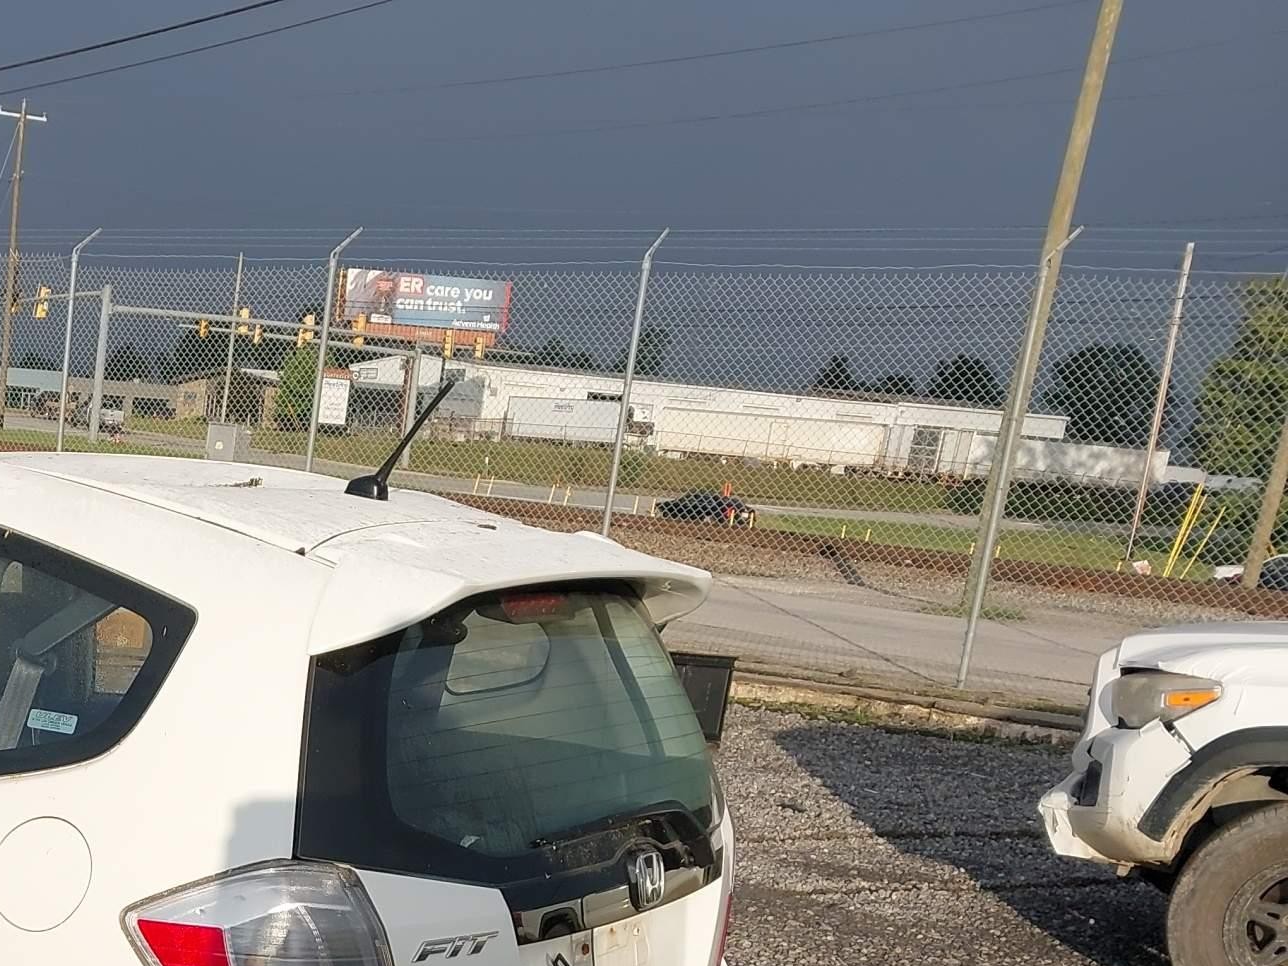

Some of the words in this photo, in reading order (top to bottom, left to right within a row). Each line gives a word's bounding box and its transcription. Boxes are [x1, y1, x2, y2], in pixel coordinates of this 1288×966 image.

[399, 276, 424, 295] ER
[426, 285, 460, 298] care
[463, 288, 493, 302] you
[396, 298, 424, 310] can
[425, 298, 466, 314] trust.
